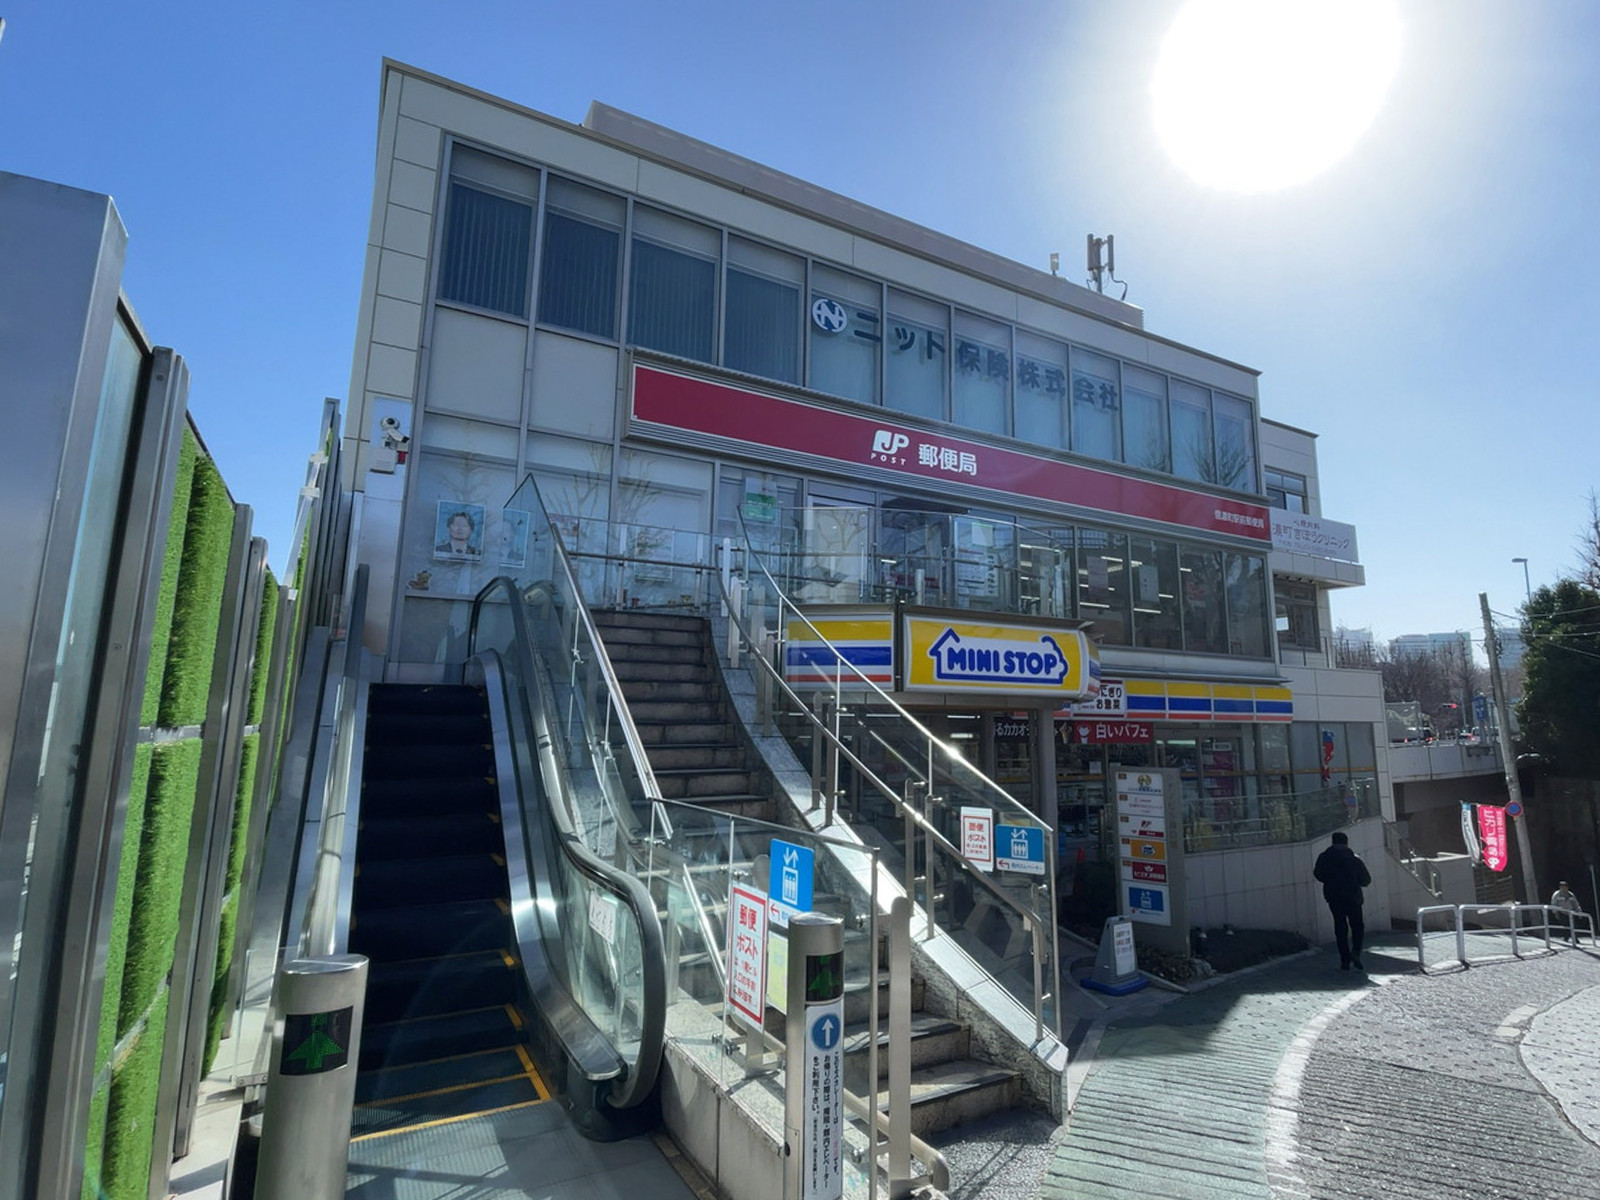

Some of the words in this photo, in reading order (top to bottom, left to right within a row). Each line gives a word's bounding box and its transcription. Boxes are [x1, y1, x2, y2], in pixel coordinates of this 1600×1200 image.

[853, 311, 1119, 411] ニット保険株式会社
[873, 430, 910, 455] JP
[870, 452, 906, 466] POST
[919, 443, 977, 477] 郵便局
[946, 647, 1000, 673] MINI
[1003, 650, 1059, 676] STOP
[1096, 699, 1121, 710] お惣菜
[994, 722, 1030, 737] るカカオ
[1095, 722, 1150, 739] 白いパフェ
[739, 903, 757, 932] 郵便
[736, 931, 759, 961] ポスト
